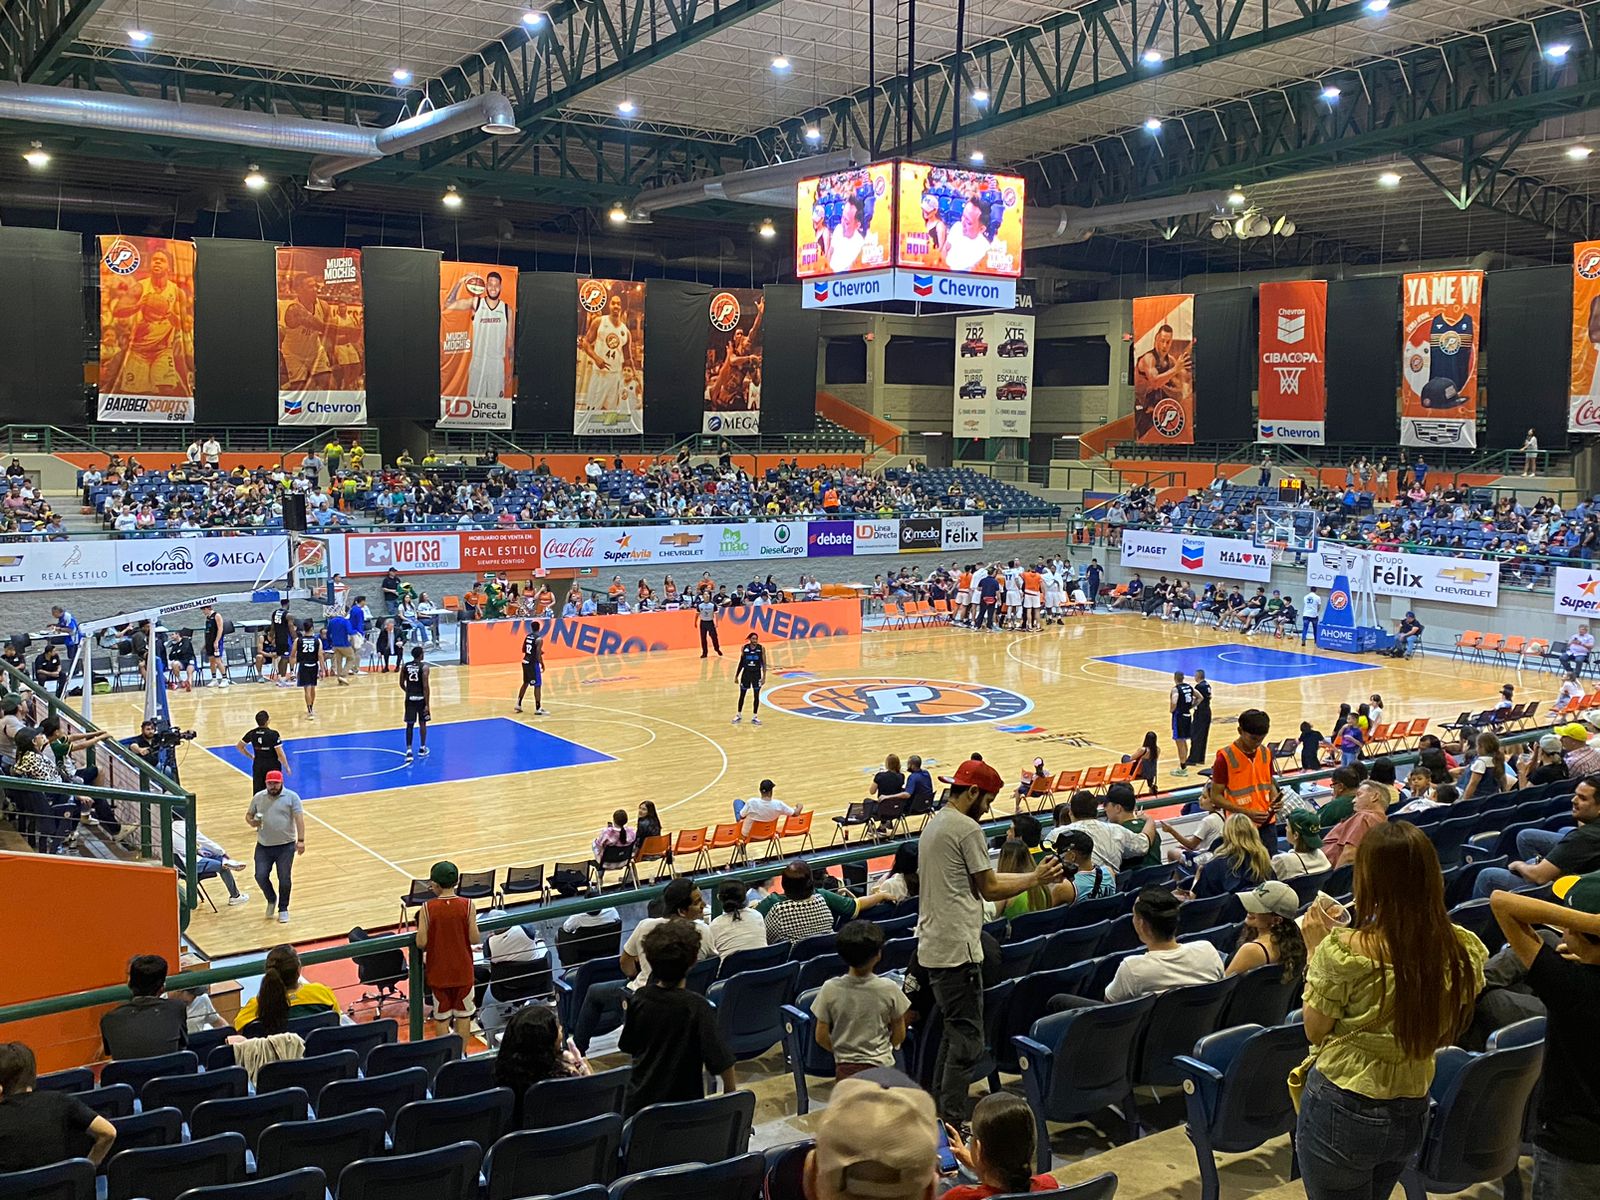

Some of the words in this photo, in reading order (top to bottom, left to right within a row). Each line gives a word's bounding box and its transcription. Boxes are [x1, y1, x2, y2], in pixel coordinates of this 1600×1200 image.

[326, 257, 353, 269] MUCHO
[324, 266, 356, 280] MOCHIS
[832, 280, 880, 297] Chevron
[938, 278, 999, 299] Chevron
[1406, 277, 1429, 306] YA
[1431, 276, 1457, 305] ME
[1278, 308, 1306, 316] Chevron
[446, 331, 468, 341] MUCHO
[965, 327, 984, 340] ZR2
[1004, 327, 1024, 340] XT5
[443, 339, 471, 351] MOCHIS
[605, 350, 616, 361] 44
[1263, 352, 1318, 363] CIBACOPA
[996, 374, 1028, 383] ESCALADE
[307, 401, 362, 414] Chevron
[472, 409, 507, 420] Directa
[721, 416, 760, 431] MEGA
[1276, 426, 1320, 439] Chevron
[945, 519, 966, 529] Grupo
[507, 533, 521, 541] VENTA
[817, 531, 852, 546] debate
[873, 531, 898, 540] Directa
[945, 527, 978, 544] Félix
[1182, 537, 1206, 546] Chevron
[394, 539, 441, 562] versa
[464, 546, 493, 557] REAL
[497, 544, 538, 556] ESTILO
[543, 536, 598, 559] Coca-Cola
[719, 540, 750, 552] mac
[759, 544, 804, 556] DieselCargo
[1136, 544, 1168, 555] PIAGET
[221, 552, 266, 565] MEGA
[658, 549, 704, 557] CHEVROLET
[1375, 553, 1404, 565] Grupo
[122, 560, 133, 573] el
[136, 559, 194, 571] colorado
[415, 560, 449, 569] concepto
[41, 573, 69, 581] REAL
[72, 570, 108, 580] ESTILO
[1372, 564, 1424, 589] Félix
[1435, 586, 1492, 598] CHEVROLET
[1320, 628, 1353, 641] AHOME
[302, 643, 315, 653] 25
[408, 672, 420, 682] 23
